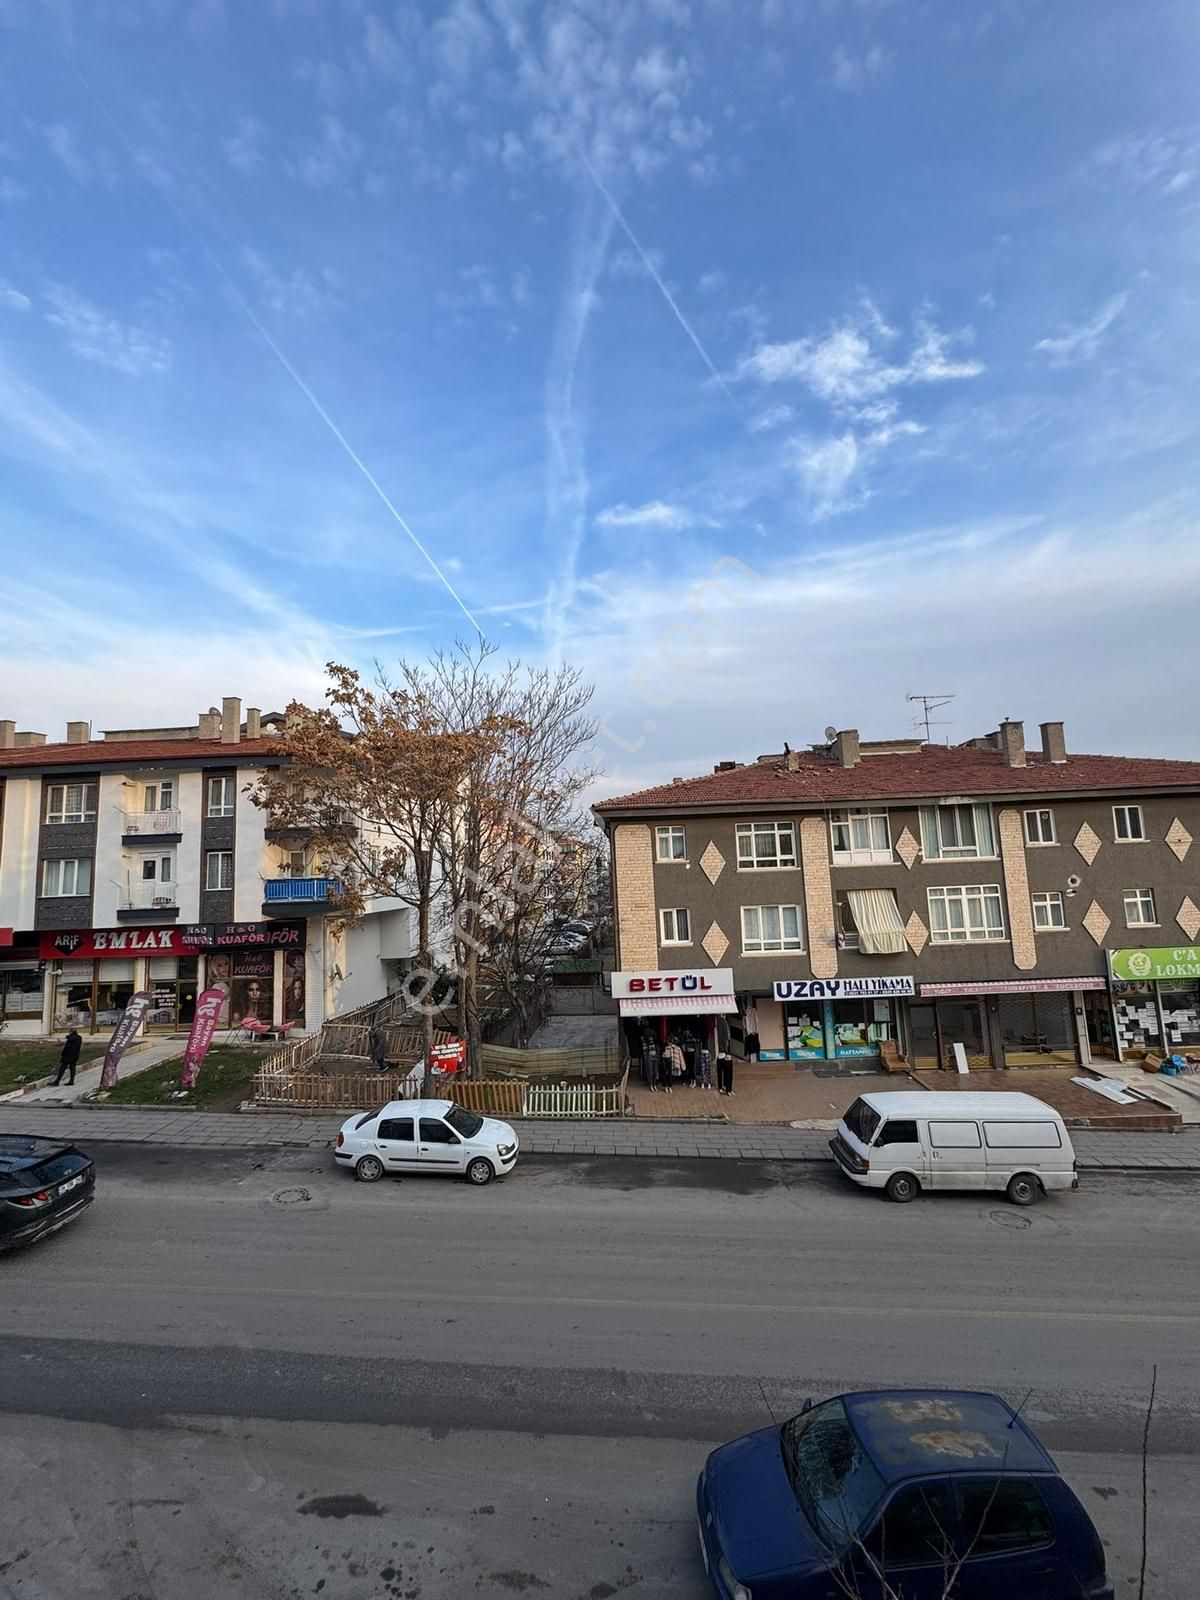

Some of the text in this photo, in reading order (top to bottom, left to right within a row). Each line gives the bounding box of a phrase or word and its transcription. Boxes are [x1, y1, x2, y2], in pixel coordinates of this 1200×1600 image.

[93, 930, 175, 949] EMLAK
[217, 933, 265, 945] KUAFÖR
[629, 974, 712, 992] BETÜL
[776, 980, 840, 998] UZAY
[200, 1019, 215, 1047] Bayan
